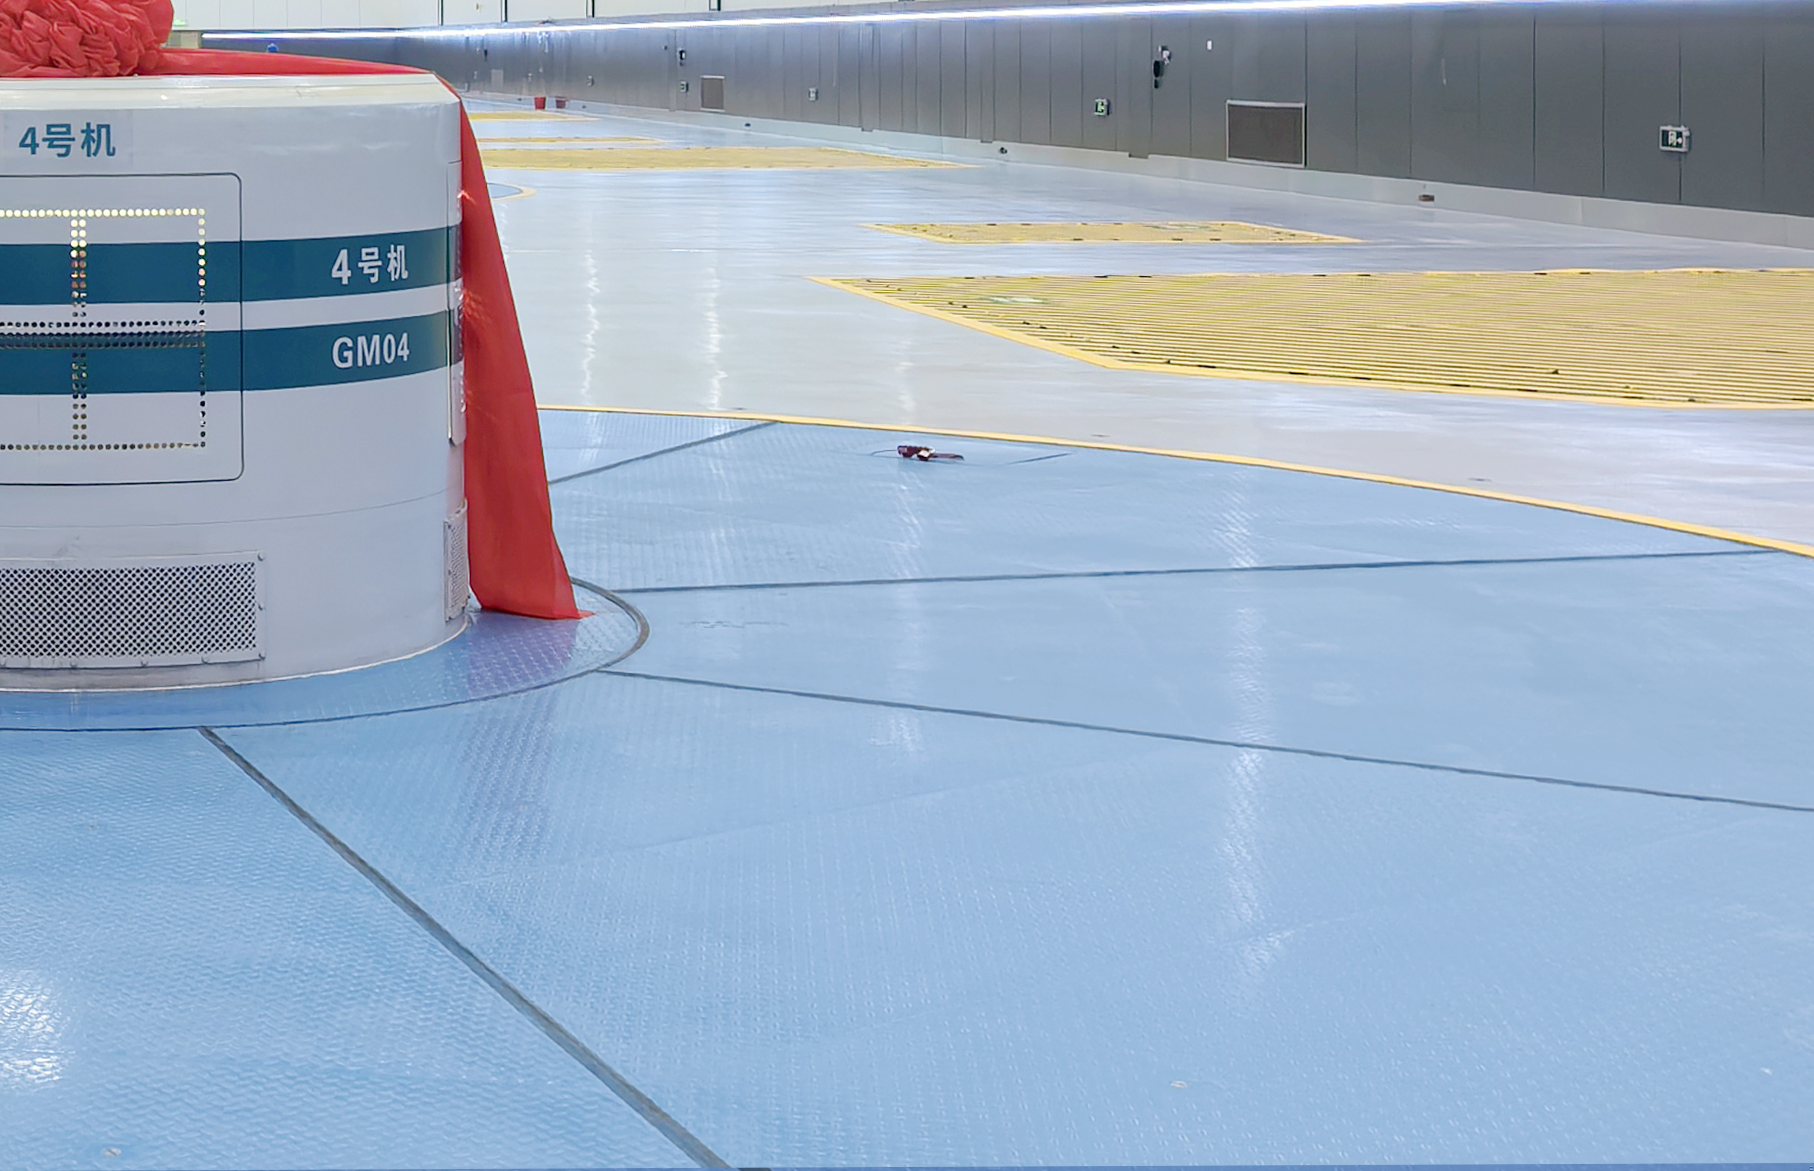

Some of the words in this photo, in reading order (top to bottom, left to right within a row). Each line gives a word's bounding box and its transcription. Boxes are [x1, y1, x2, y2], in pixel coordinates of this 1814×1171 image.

[18, 122, 116, 158] 4号机
[331, 243, 409, 285] 4号机
[332, 332, 410, 369] GM04
